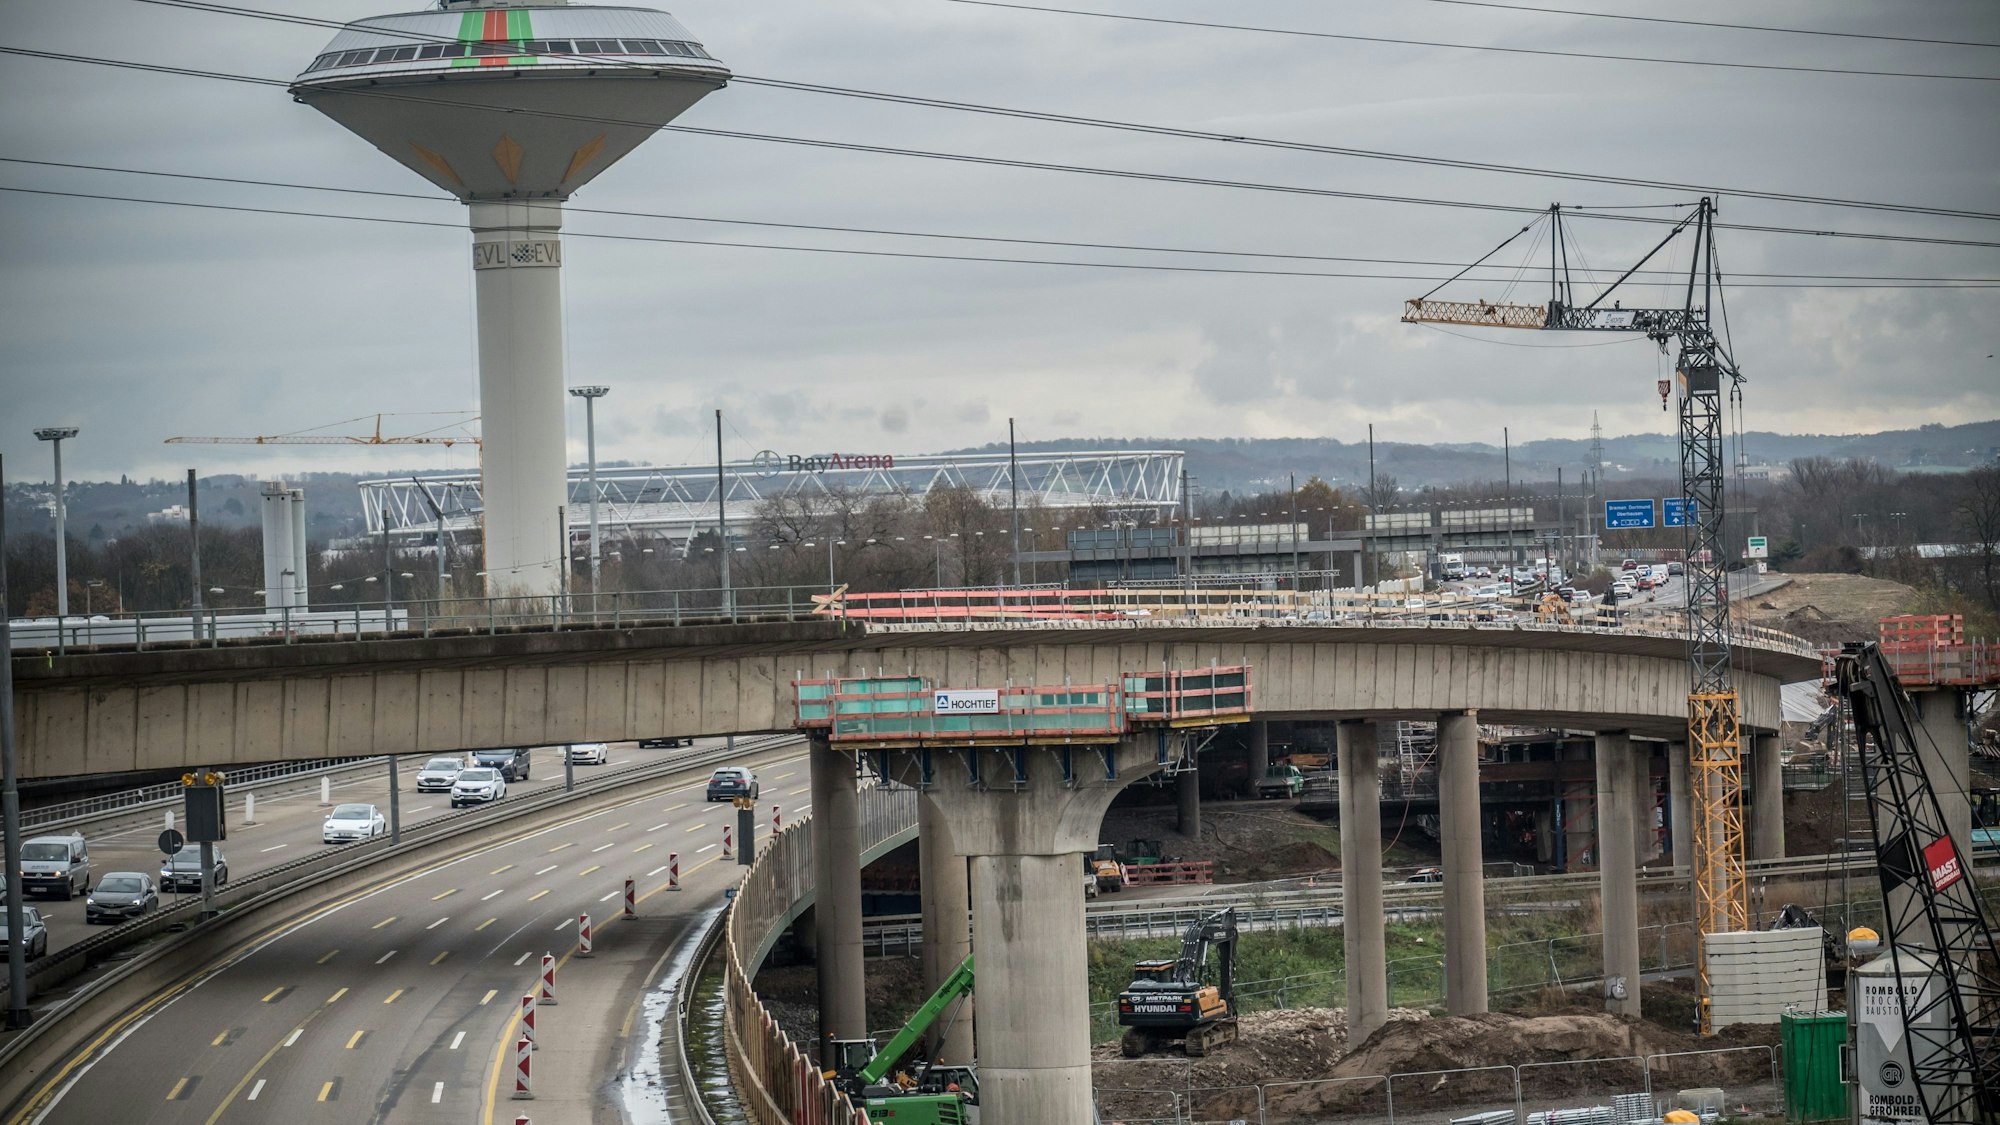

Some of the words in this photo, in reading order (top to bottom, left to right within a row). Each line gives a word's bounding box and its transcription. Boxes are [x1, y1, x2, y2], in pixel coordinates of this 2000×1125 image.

[475, 244, 506, 265] EVL
[787, 452, 894, 474] BayArena
[951, 699, 996, 708] HOCHTIEF
[1932, 857, 1957, 882] MAST
[1866, 986, 1918, 995] ROMBOLD
[1134, 1004, 1177, 1013] HYUNDAI
[1866, 1006, 1918, 1015] BAUSTOFE
[1869, 1095, 1914, 1105] ROMBOLD
[1869, 1104, 1921, 1116] GFRÖHRER
